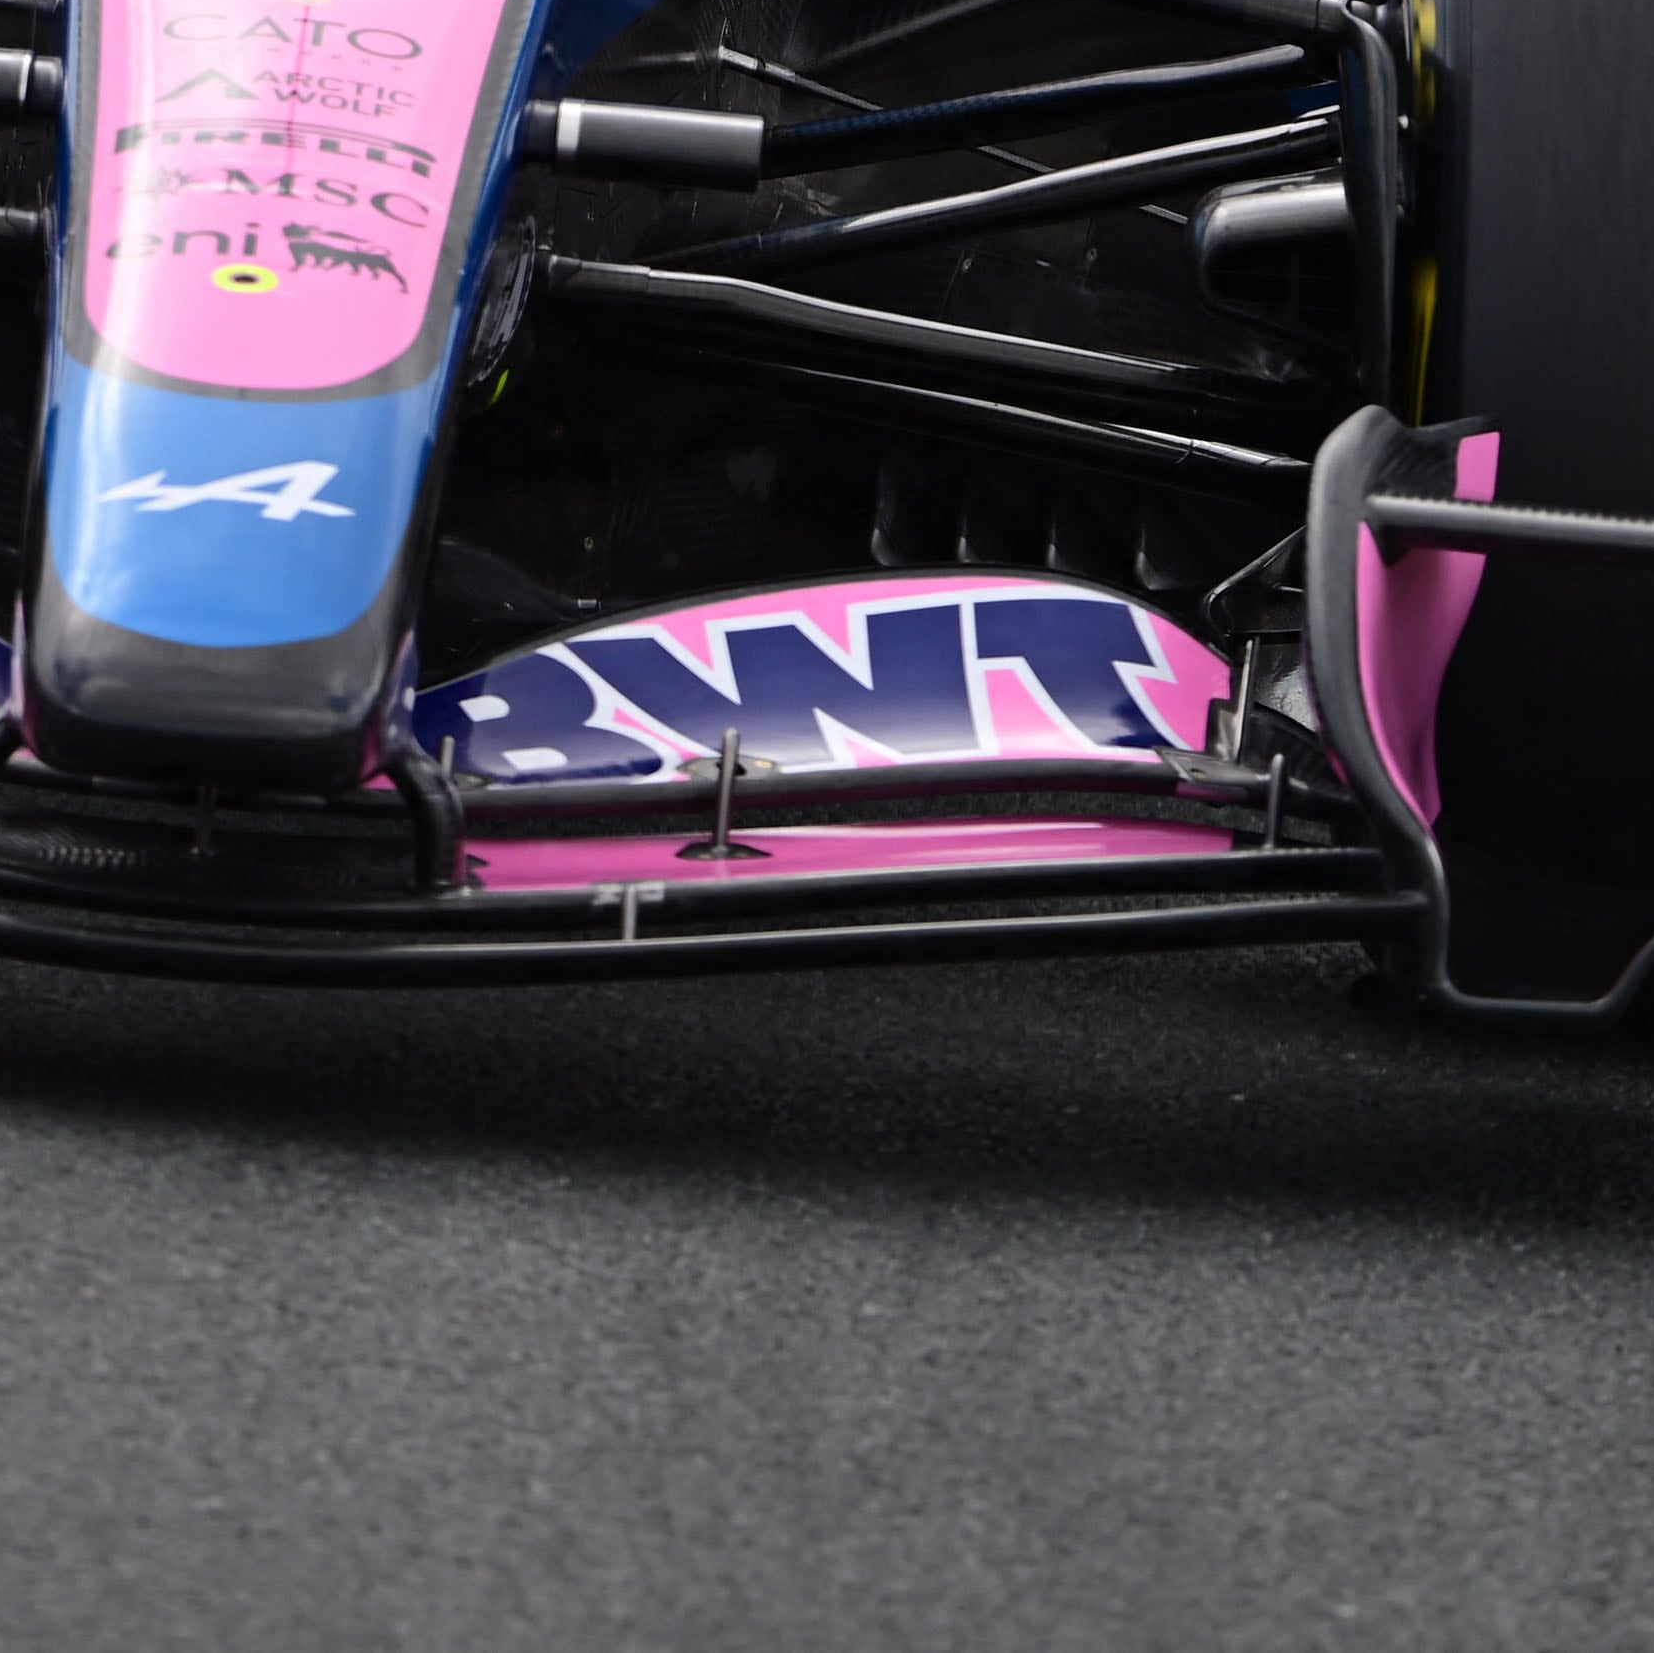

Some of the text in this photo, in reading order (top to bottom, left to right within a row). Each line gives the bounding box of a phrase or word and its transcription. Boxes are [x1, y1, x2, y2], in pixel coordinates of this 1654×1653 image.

[163, 13, 423, 60] CATO
[253, 70, 416, 107] ARCTIC
[273, 87, 398, 118] WOLF
[113, 118, 437, 179] PIRELLI
[222, 168, 430, 229] MSC
[105, 221, 261, 260] eni
[412, 584, 1192, 784] BWT
